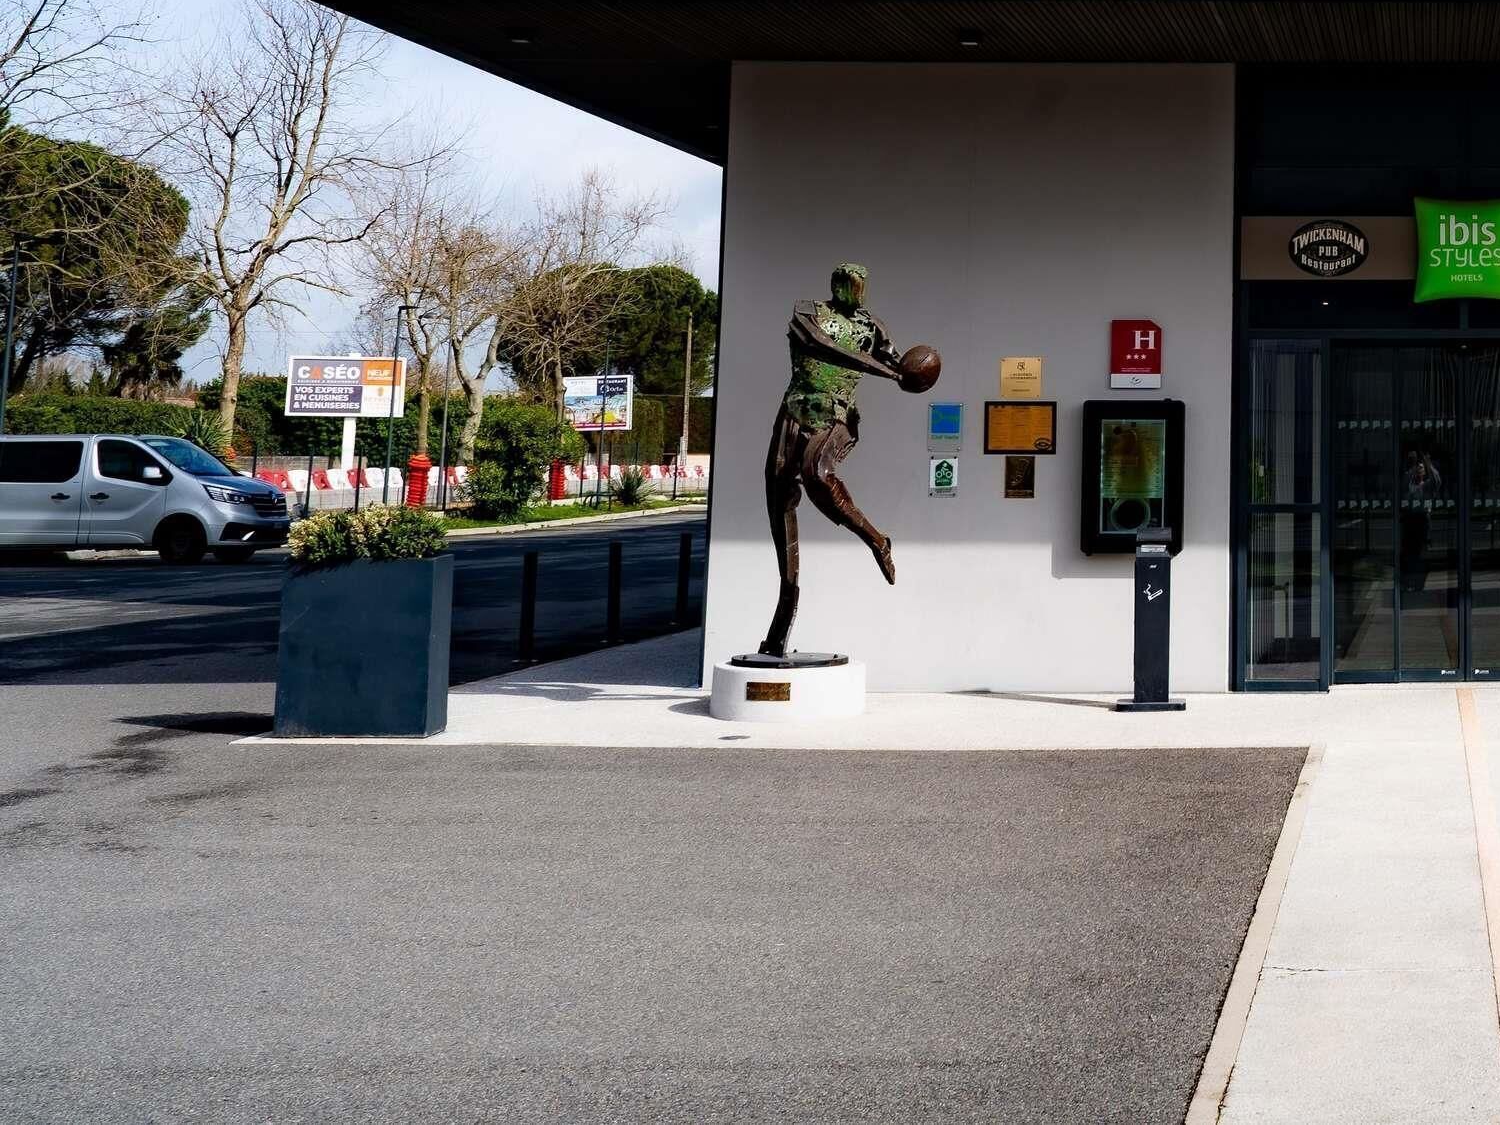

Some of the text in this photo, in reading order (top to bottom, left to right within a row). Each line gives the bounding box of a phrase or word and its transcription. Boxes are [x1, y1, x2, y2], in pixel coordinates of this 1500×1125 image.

[1439, 214, 1496, 246] ibis
[1292, 228, 1365, 255] TWICKENHAM
[1318, 245, 1339, 257] PUB
[1301, 254, 1356, 271] Restaurant
[1450, 274, 1483, 283] HOTELS
[1133, 330, 1156, 350] H
[295, 386, 354, 394] VOS EXPERTS
[302, 402, 361, 410] MENUISERIES
